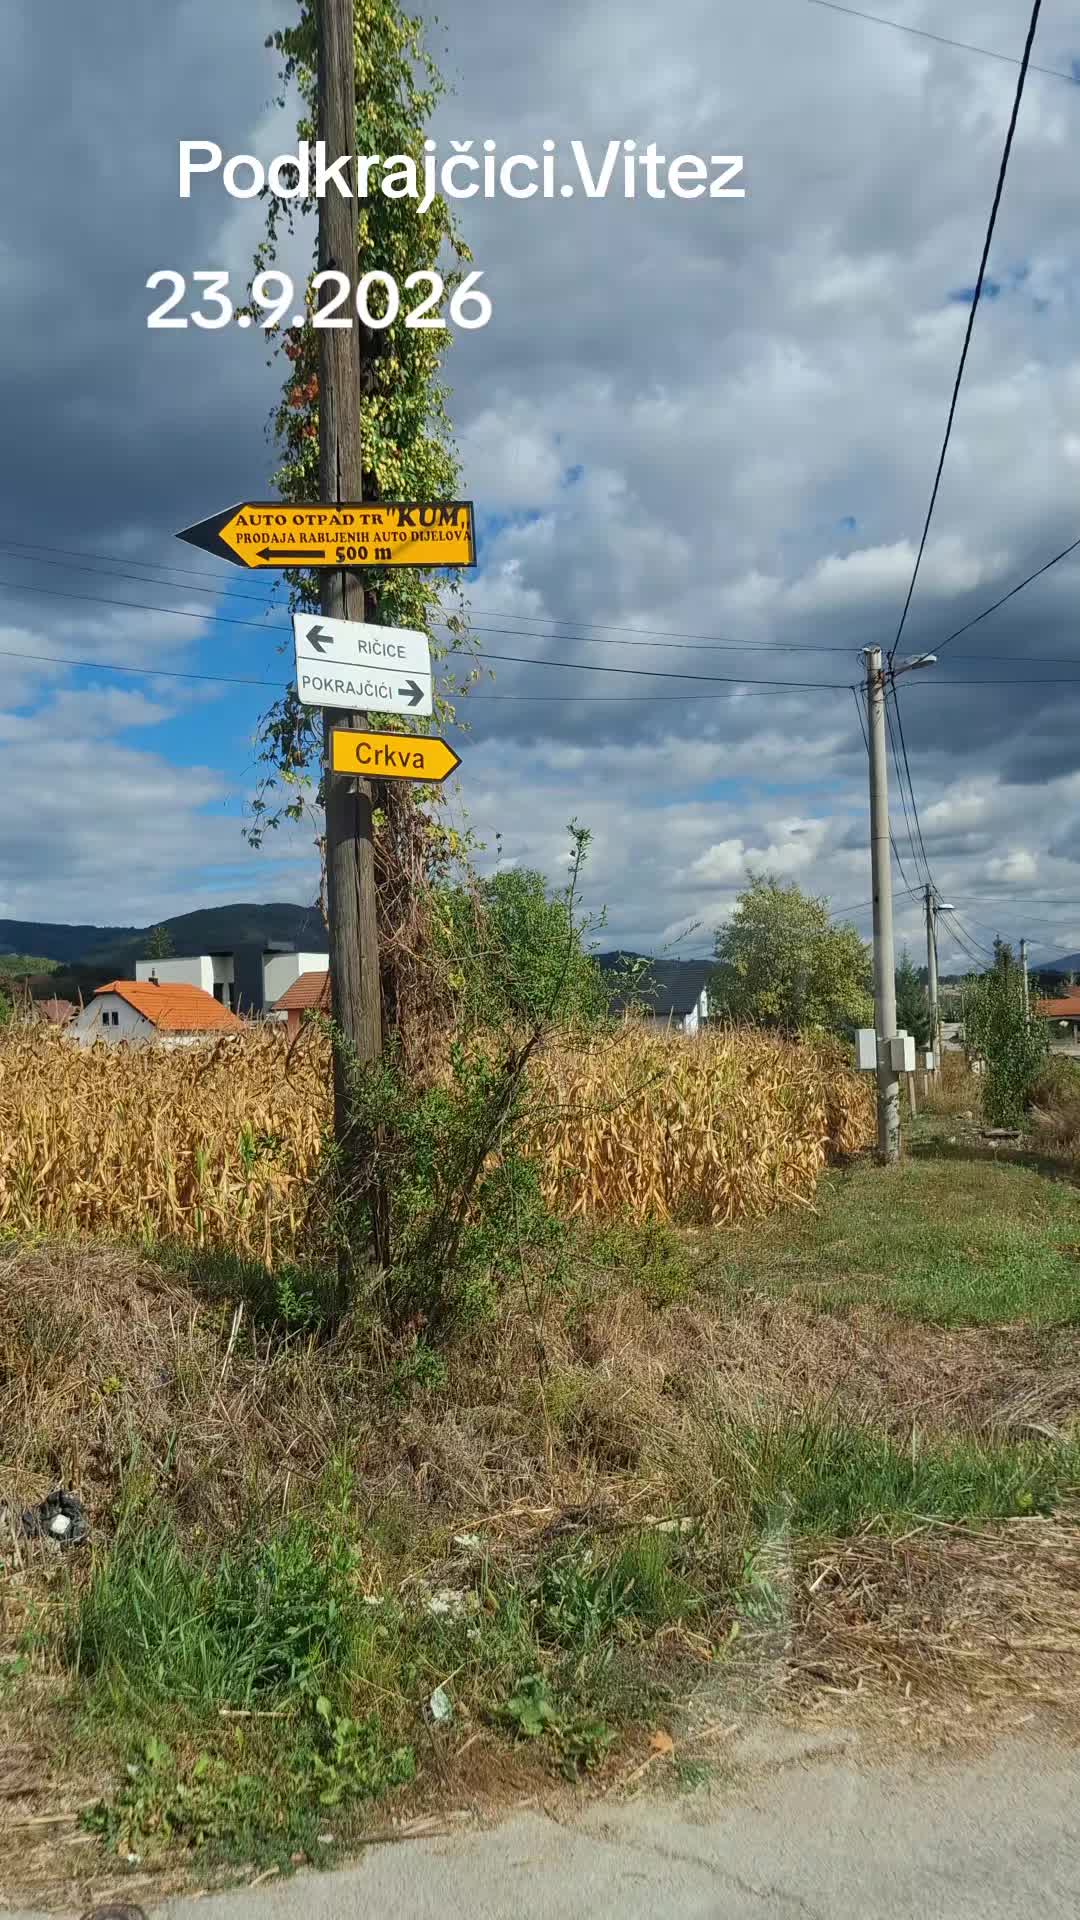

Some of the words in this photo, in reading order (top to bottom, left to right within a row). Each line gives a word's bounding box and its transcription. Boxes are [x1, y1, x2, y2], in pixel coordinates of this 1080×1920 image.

[235, 514, 287, 526] AUTO
[292, 514, 355, 526] OTPAD
[359, 513, 383, 526] TR
[236, 532, 296, 544] PRODAJA
[300, 530, 370, 544] RABLJENIH
[373, 529, 407, 543] AUTO
[410, 528, 472, 542] DIJELOVA
[335, 546, 368, 563] 500
[374, 545, 393, 560] m
[357, 638, 408, 659] RIČICE
[302, 675, 393, 700] POKRAJČIĆI
[355, 742, 425, 769] Crkva
